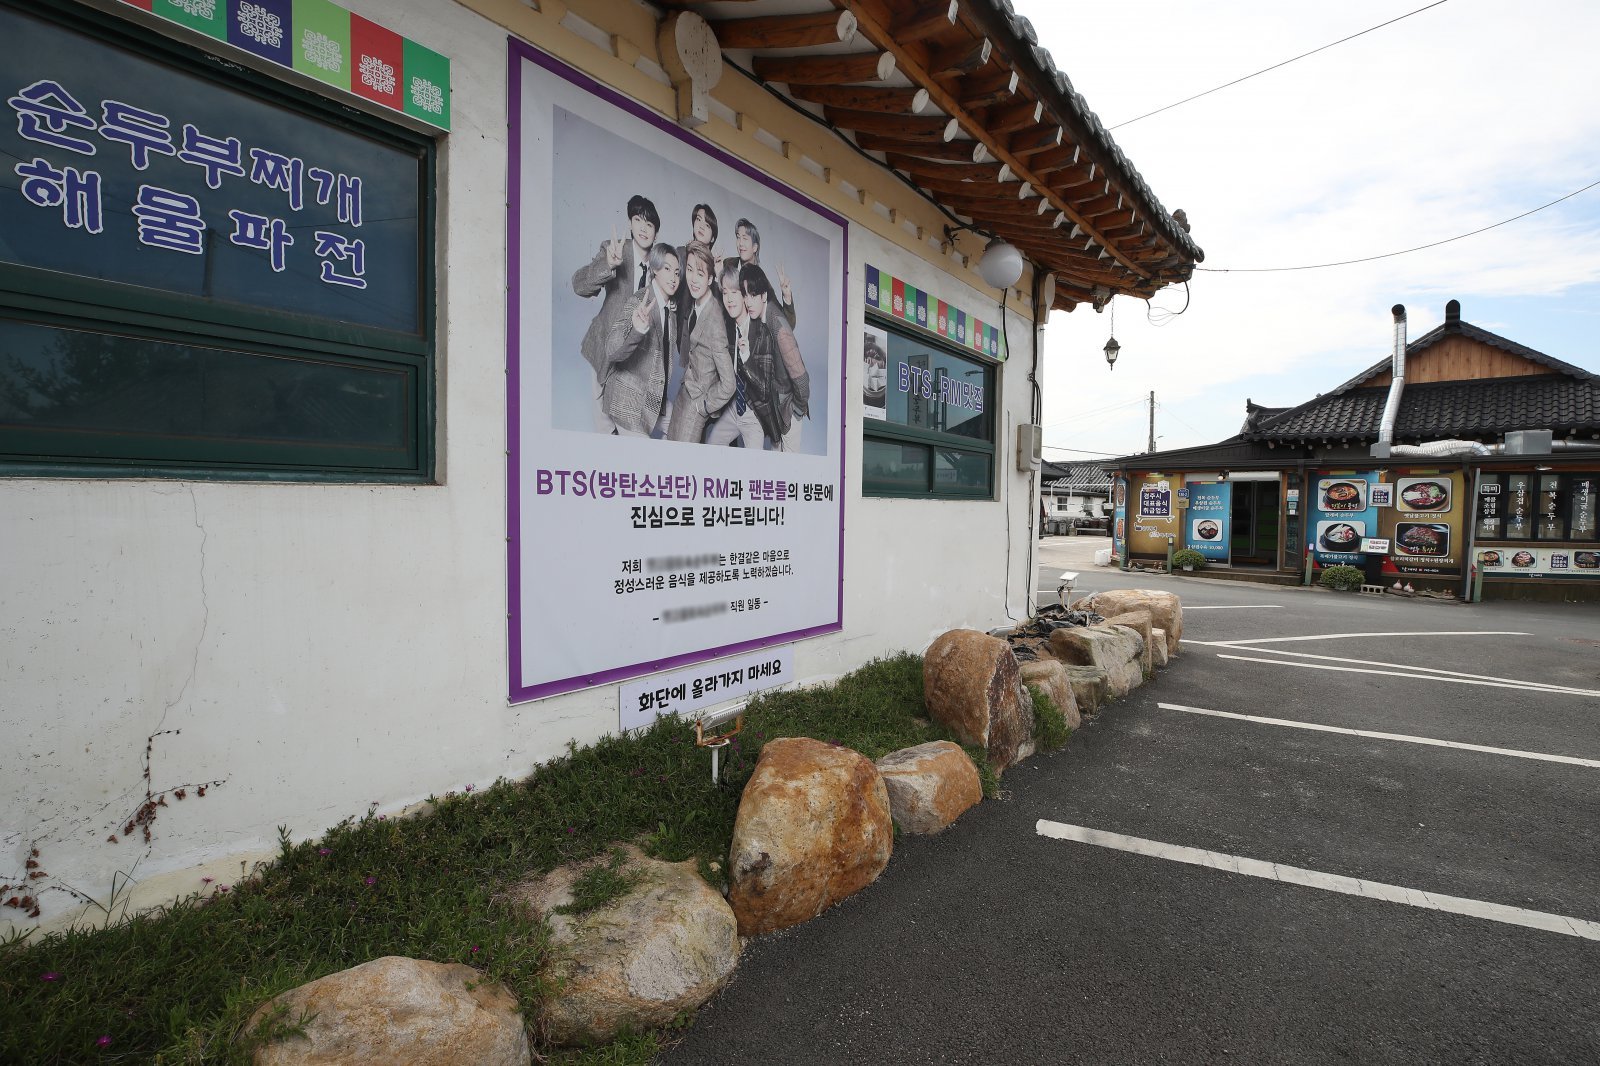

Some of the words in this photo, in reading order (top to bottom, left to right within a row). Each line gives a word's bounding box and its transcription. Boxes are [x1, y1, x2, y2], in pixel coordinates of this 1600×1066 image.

[8, 79, 362, 226] 순두부찌개
[15, 158, 367, 289] 해물파전
[536, 469, 697, 500] BTS(방탄소년단)
[703, 477, 743, 500] RM과
[748, 479, 798, 501] 팬분들의
[803, 483, 834, 502] 방문에
[630, 506, 696, 529] 진심으로
[702, 506, 785, 527] 감사드립니다!
[621, 558, 642, 574] 저희
[729, 551, 760, 566] 한결같은
[762, 549, 790, 563] 마음으로
[614, 575, 665, 595] 정성스러운
[668, 572, 696, 589] 음식을
[698, 568, 740, 585] 제공하도록
[742, 563, 794, 580] 노력하겠습니다.
[730, 600, 745, 612] 직원
[747, 597, 761, 611] 일동
[638, 683, 686, 712] 화단에
[691, 668, 744, 699] 올라가지
[748, 659, 782, 680] 마세요
